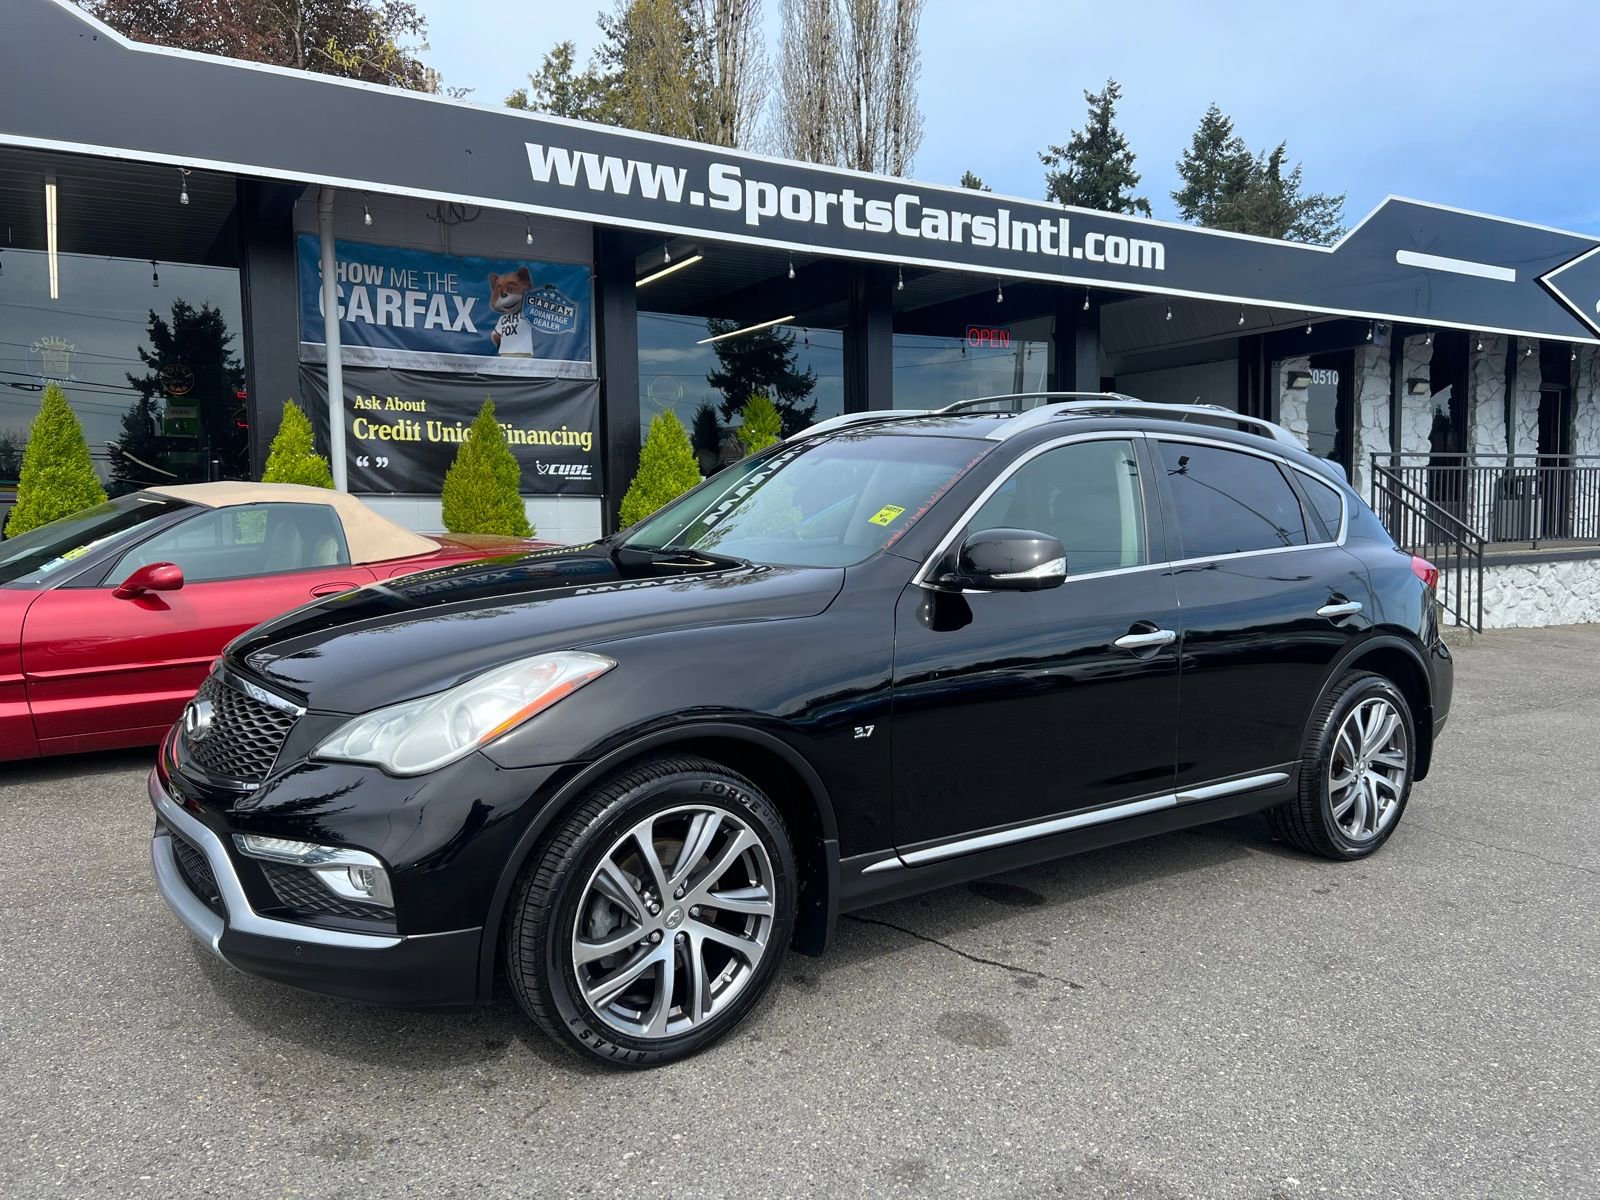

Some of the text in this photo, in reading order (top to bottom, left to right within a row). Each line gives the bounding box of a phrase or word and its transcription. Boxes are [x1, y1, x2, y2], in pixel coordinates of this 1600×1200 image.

[390, 267, 419, 290] ME
[423, 271, 458, 294] THE
[527, 297, 574, 317] CARFAX
[529, 307, 569, 325] ADVANTAGE
[501, 324, 518, 337] FOX
[533, 318, 560, 331] DEALER
[968, 328, 1010, 349] OPEN
[353, 395, 426, 412] Ask About
[352, 417, 422, 442] Credit
[548, 463, 592, 476] CUDL
[853, 724, 875, 739] 3.7
[699, 781, 762, 814] FORCE
[578, 1028, 648, 1062] ATLAS
